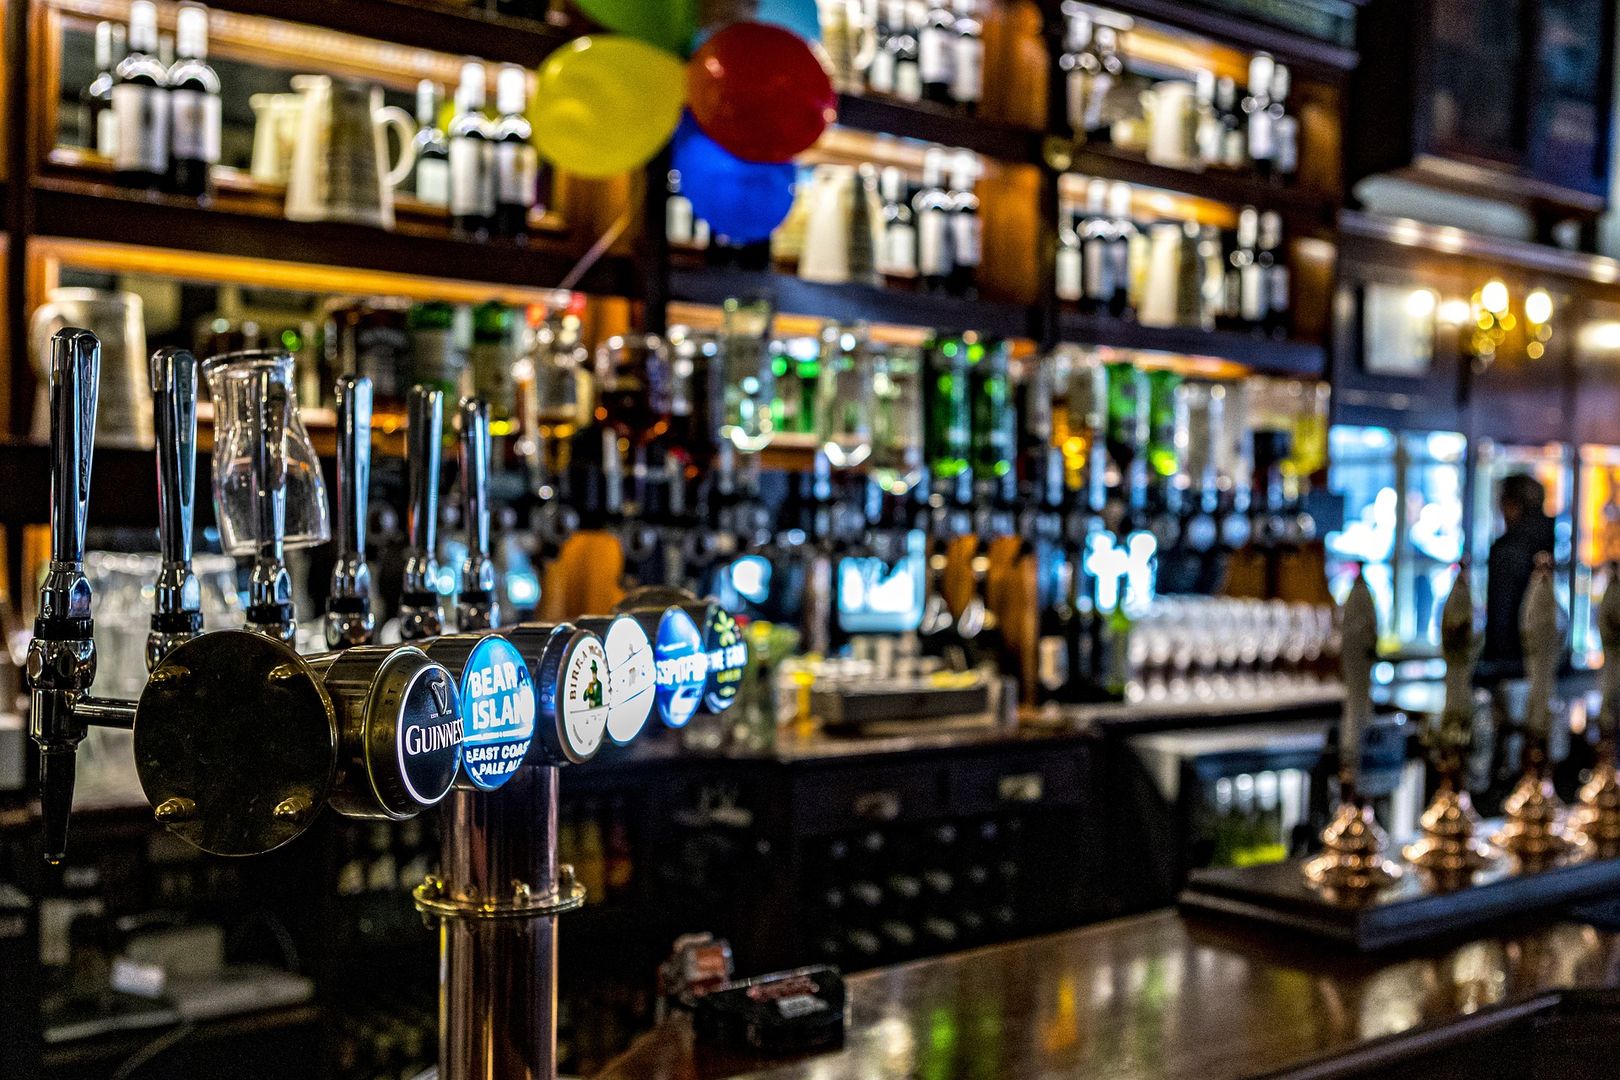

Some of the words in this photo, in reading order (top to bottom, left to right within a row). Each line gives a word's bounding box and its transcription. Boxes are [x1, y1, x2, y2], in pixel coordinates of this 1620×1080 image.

[471, 661, 518, 698] BEAR
[472, 693, 534, 730] ISLAN
[472, 746, 500, 762] EAST
[501, 740, 531, 760] COAS
[479, 761, 505, 776] PALE
